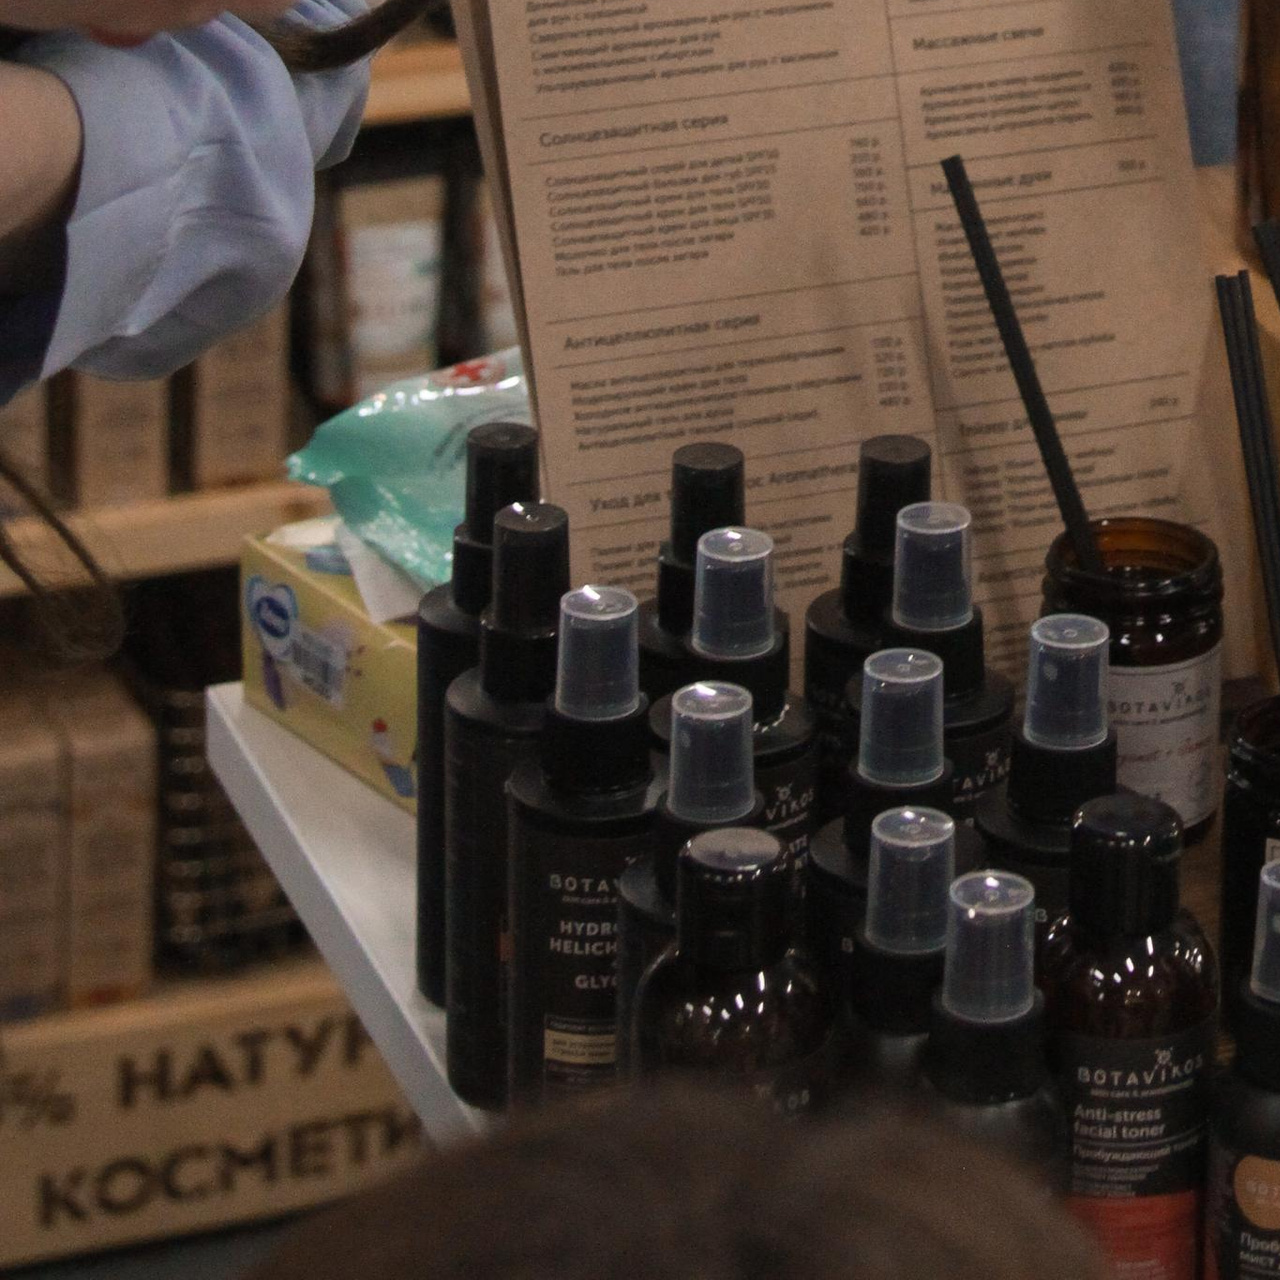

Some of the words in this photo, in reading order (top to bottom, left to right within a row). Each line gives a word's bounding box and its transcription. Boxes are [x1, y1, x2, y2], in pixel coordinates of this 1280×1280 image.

[538, 117, 679, 148] Солнцезащитная
[681, 113, 729, 131] серия
[559, 919, 618, 936] HYDR
[575, 974, 617, 990] GLY
[1077, 1054, 1204, 1086] BOTAVIKOS
[1074, 1103, 1162, 1123] Anti-stress
[1074, 1121, 1117, 1139] facial
[1121, 1123, 1166, 1138] toner
